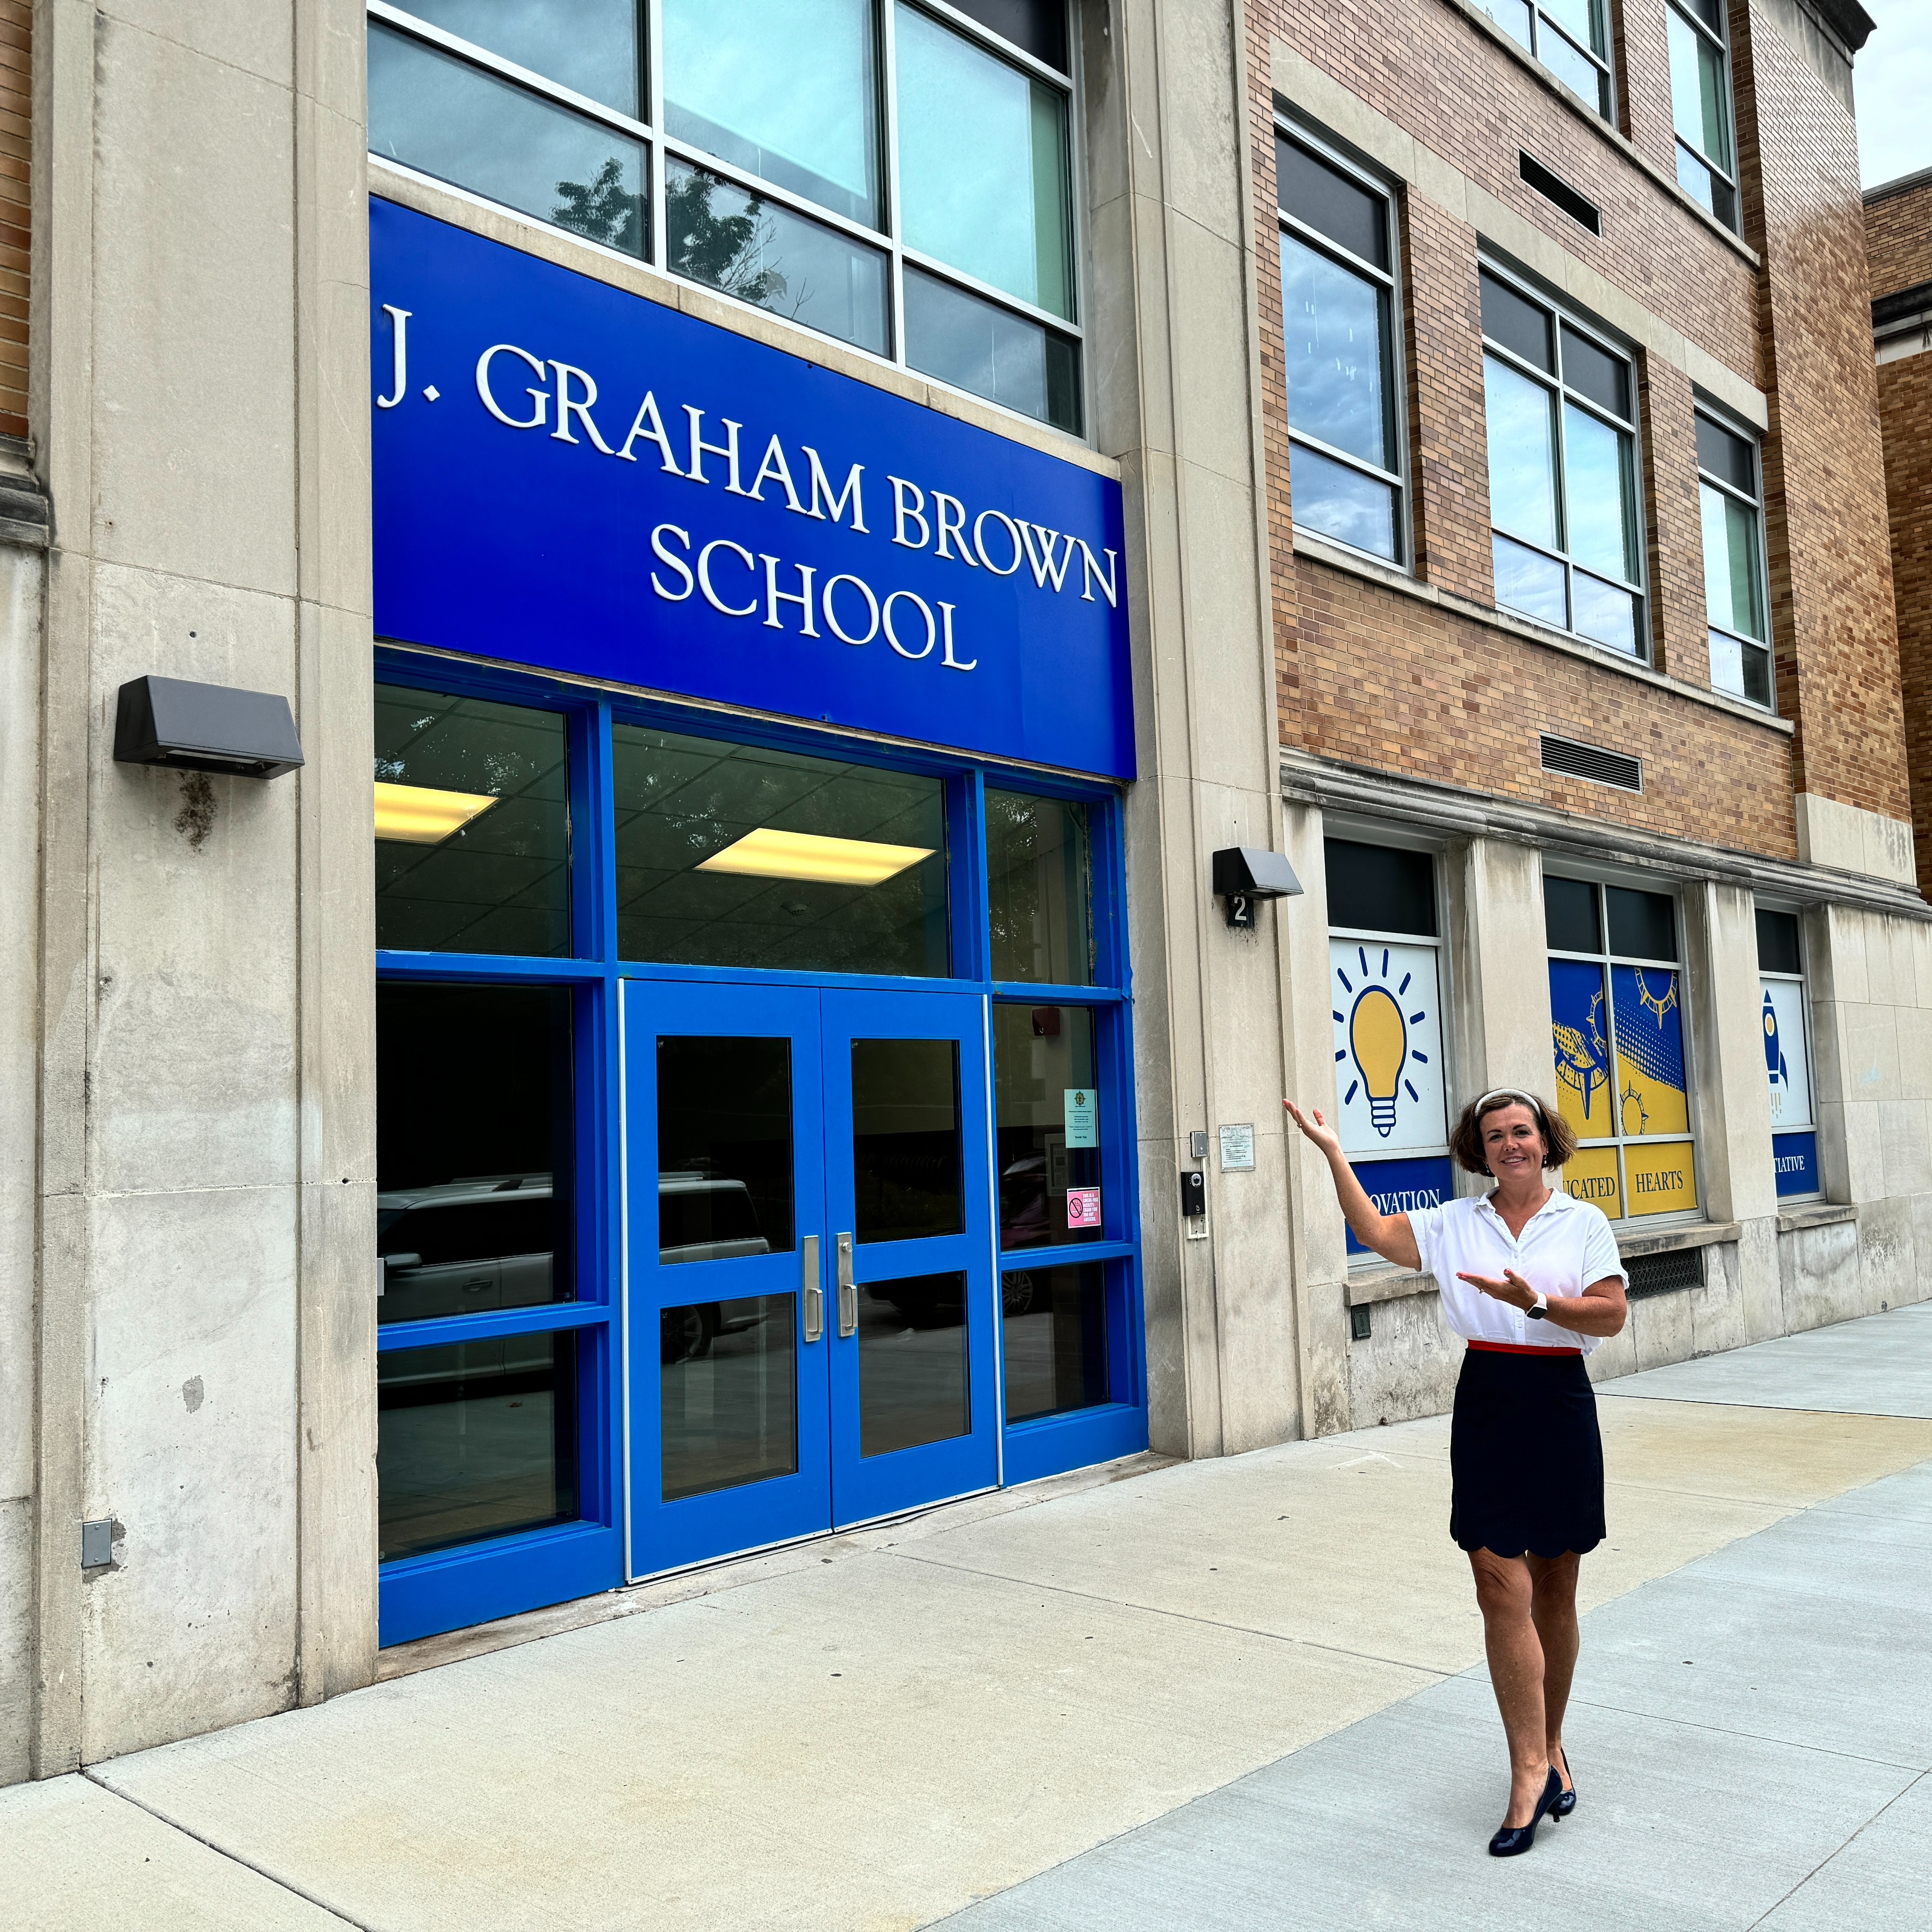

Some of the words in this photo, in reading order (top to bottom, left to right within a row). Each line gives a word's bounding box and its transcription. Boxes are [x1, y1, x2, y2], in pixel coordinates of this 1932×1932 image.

[377, 304, 440, 408] J.
[476, 344, 870, 534] GRAHAM
[887, 475, 1118, 607] BROWN
[651, 524, 977, 671] SCHOOL
[1234, 896, 1247, 921] 2
[1635, 1170, 1684, 1193] HEARTS
